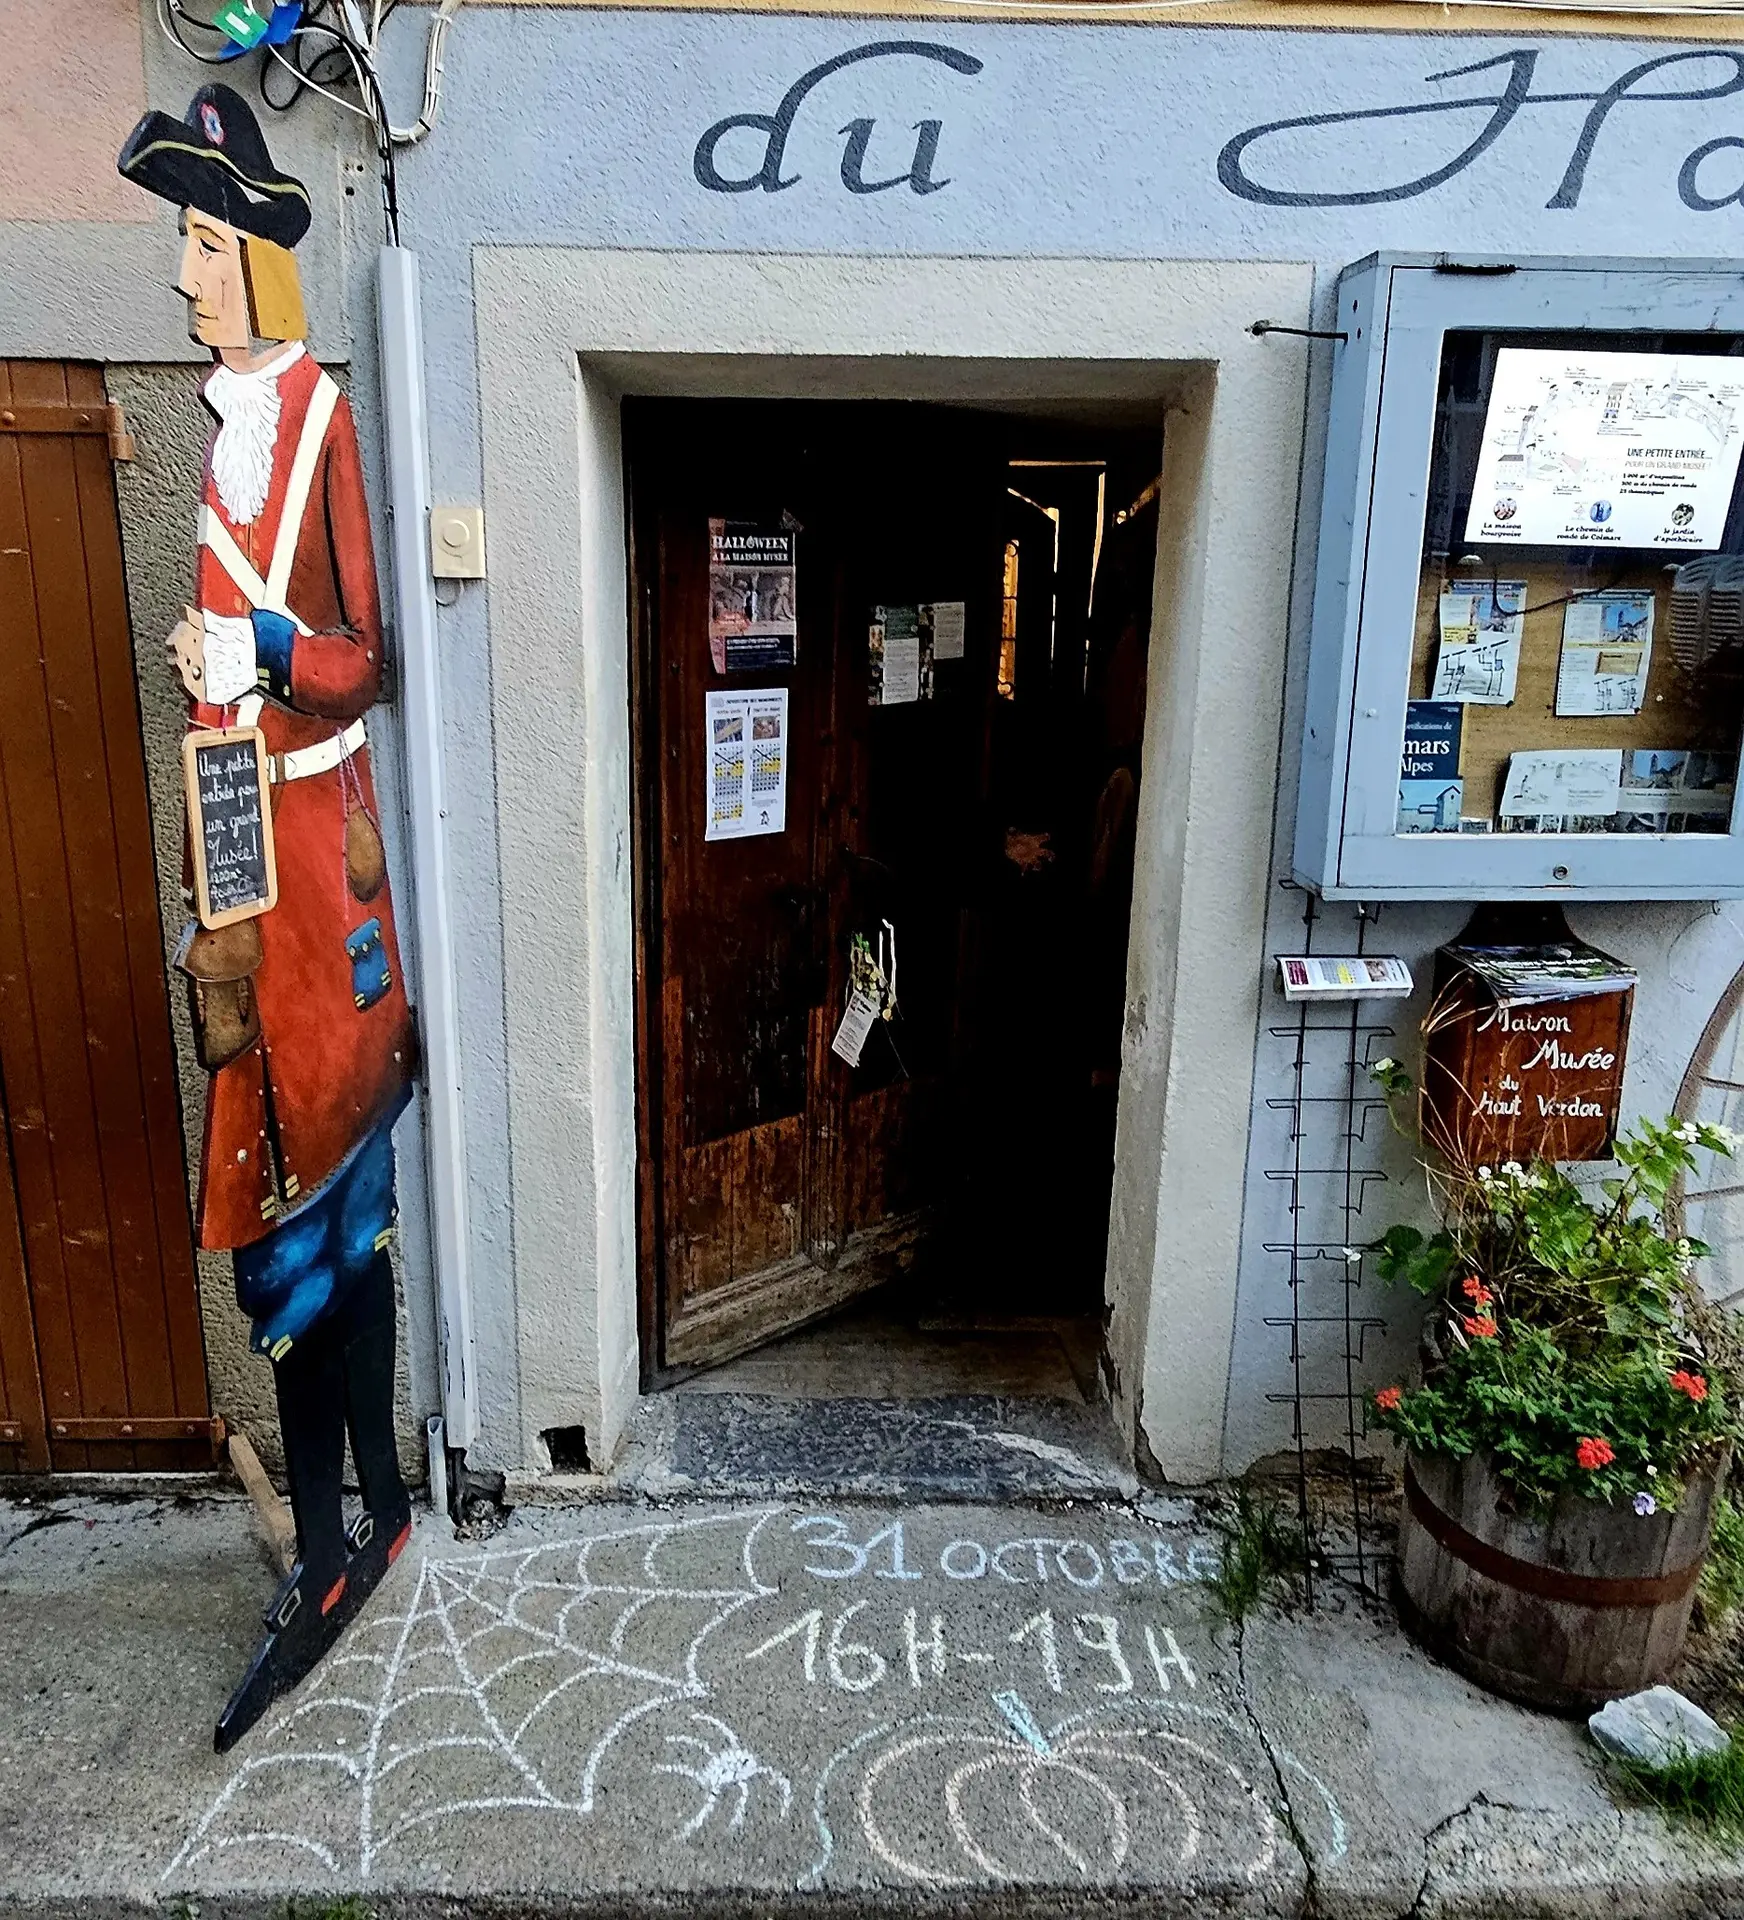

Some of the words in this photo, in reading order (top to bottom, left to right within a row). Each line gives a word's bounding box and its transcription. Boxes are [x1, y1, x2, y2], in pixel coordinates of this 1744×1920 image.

[693, 40, 984, 194] du
[1627, 447, 1645, 457] UNE
[1645, 447, 1674, 459] PETITE
[1576, 525, 1604, 533] chemin
[712, 535, 789, 551] HALLOWEEN
[732, 552, 761, 561] MAISON
[206, 820, 227, 835] un
[1477, 1008, 1572, 1033] Maison
[1521, 1038, 1616, 1070] Musée
[1499, 1073, 1520, 1091] du
[1537, 1094, 1604, 1118] Verdon
[790, 1517, 923, 1580] 31
